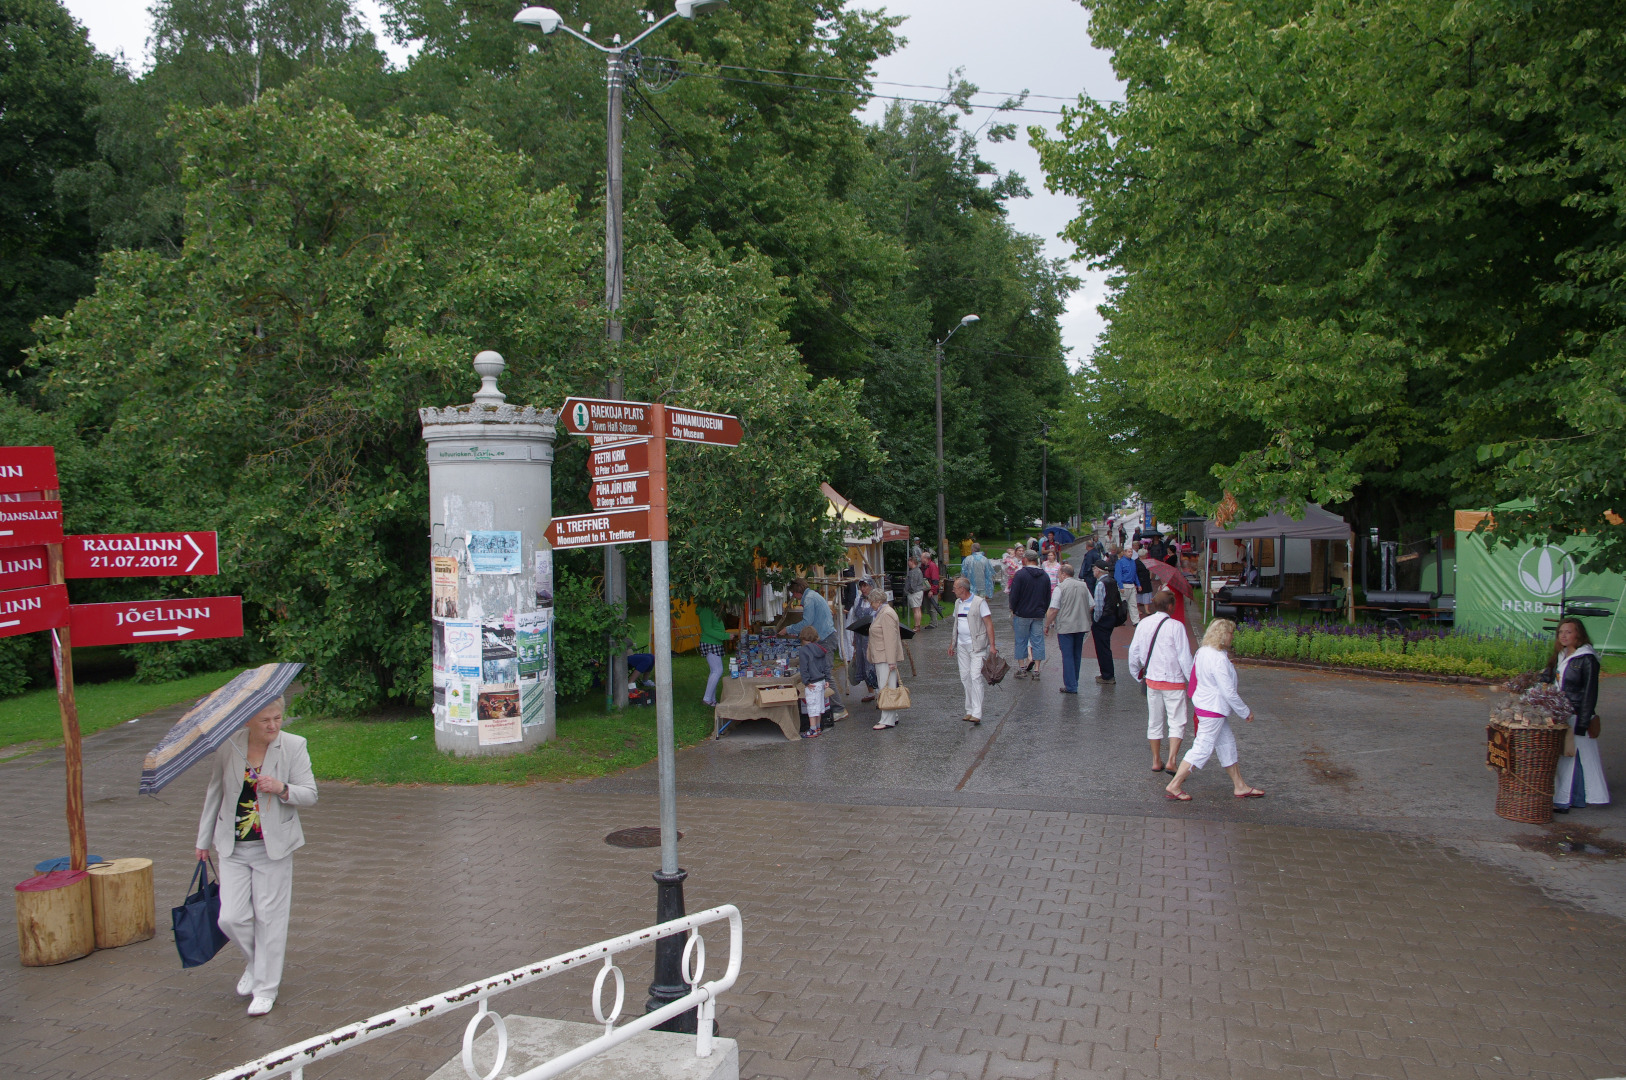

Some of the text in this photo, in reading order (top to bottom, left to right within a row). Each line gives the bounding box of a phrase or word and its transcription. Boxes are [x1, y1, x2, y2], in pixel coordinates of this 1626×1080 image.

[591, 405, 644, 421] RAEKOJA PLATS
[592, 421, 637, 434] Town Hall Square
[672, 412, 723, 430] LINNAMUUSEUM
[672, 426, 704, 440] City Museum
[594, 449, 626, 464] PEETRI KIRIK
[595, 466, 600, 476] St
[615, 462, 629, 473] Church
[596, 480, 637, 496] PÜHA JÜRI KIRIK
[620, 494, 634, 505] Church
[556, 517, 610, 534] H. TREFFNER
[83, 537, 182, 551] RAUALINN
[557, 530, 635, 546] Monument to H. Treffner
[90, 555, 178, 568] 21.07.2012
[115, 607, 210, 626] JÕELINN
